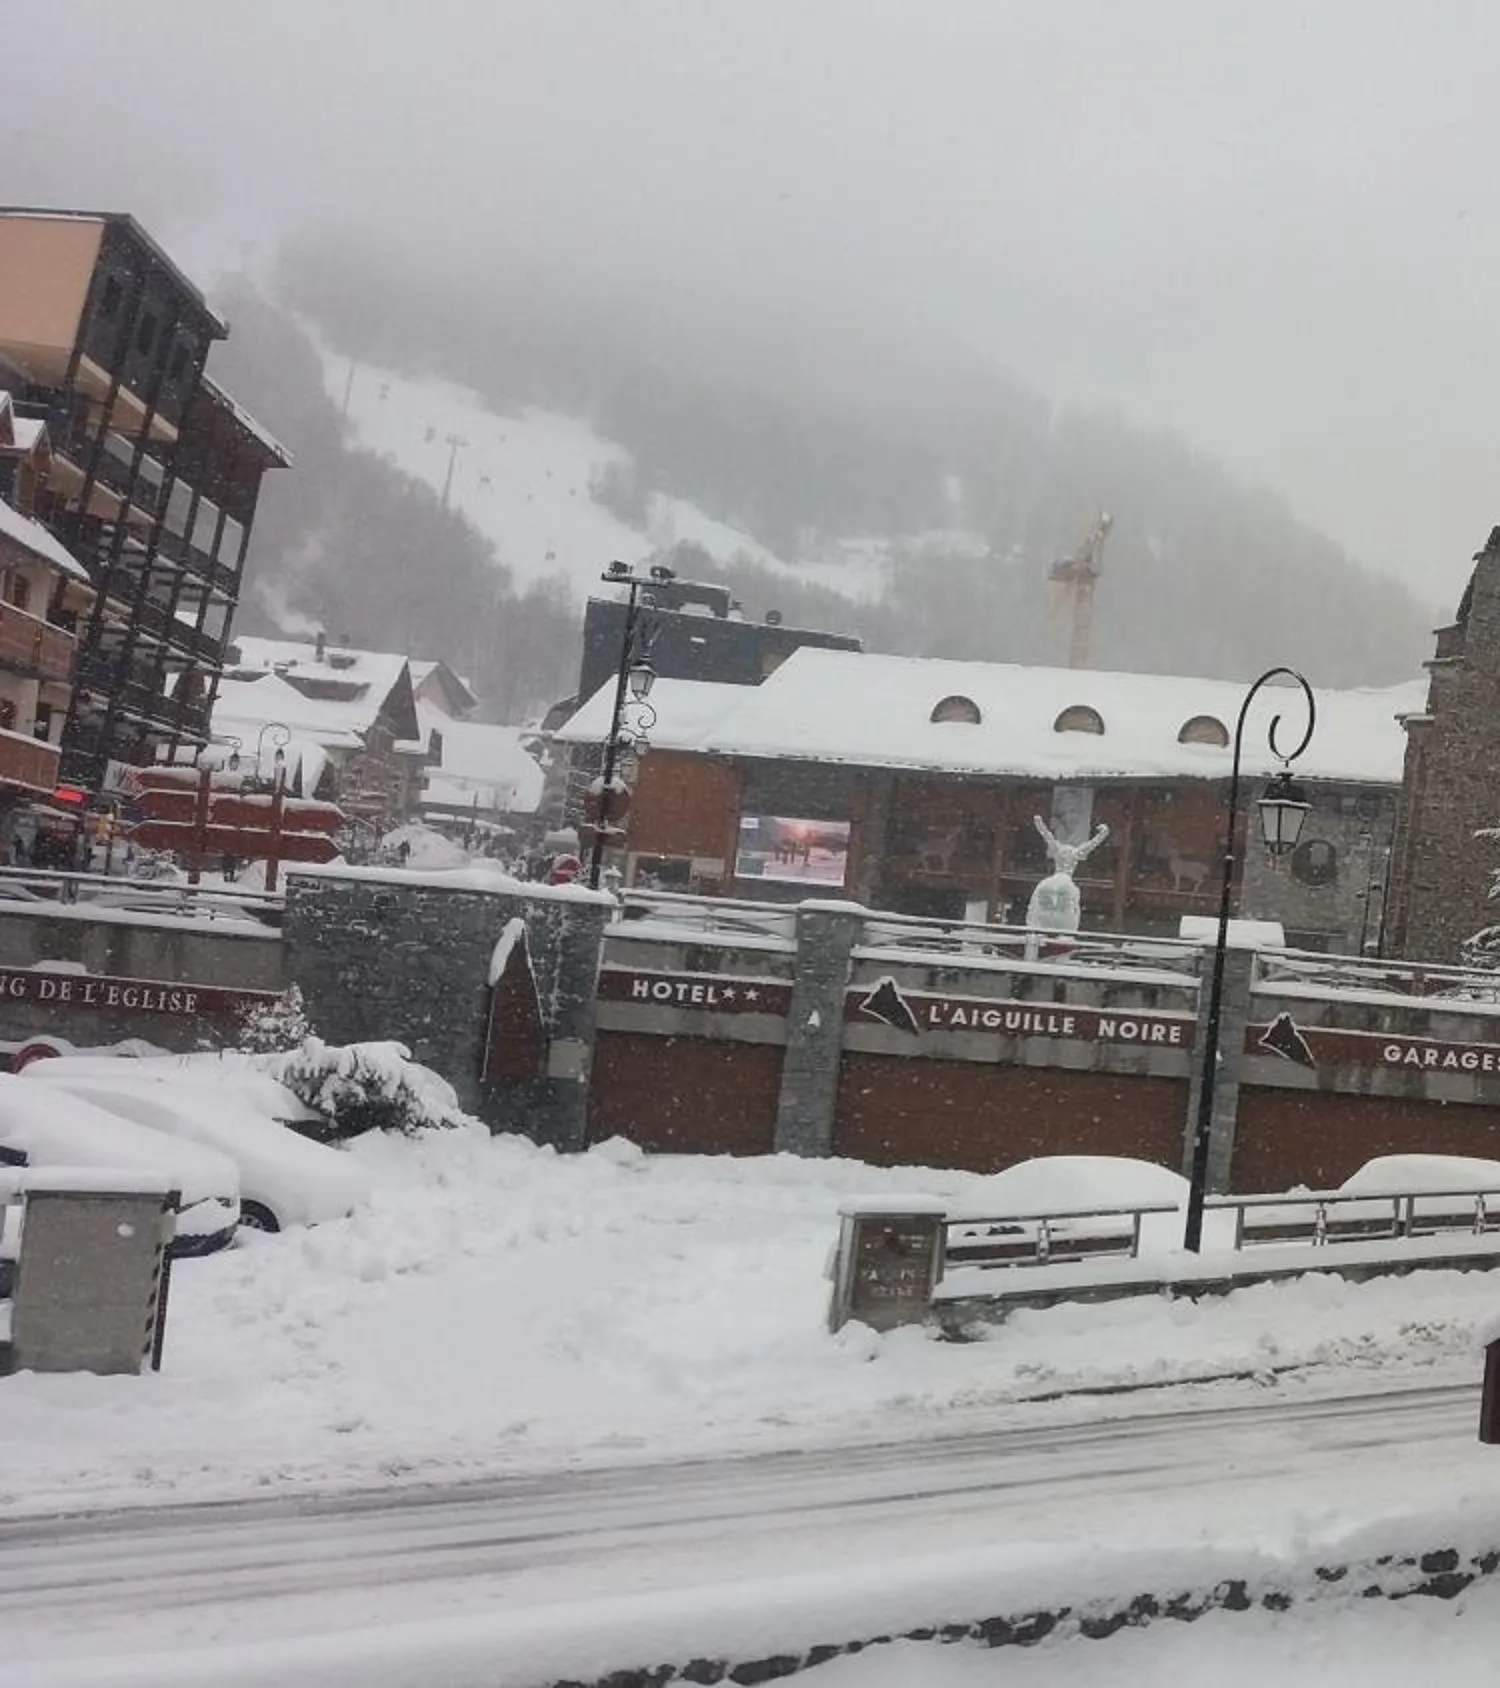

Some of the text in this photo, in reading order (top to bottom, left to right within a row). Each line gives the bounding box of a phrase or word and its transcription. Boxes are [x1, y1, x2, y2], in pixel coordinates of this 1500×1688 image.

[39, 979, 72, 1001] DE
[82, 982, 198, 1013] L'EGLISE
[632, 979, 719, 1004] HOTEL
[928, 1003, 1183, 1043] L'AIGUILLE NOIRE
